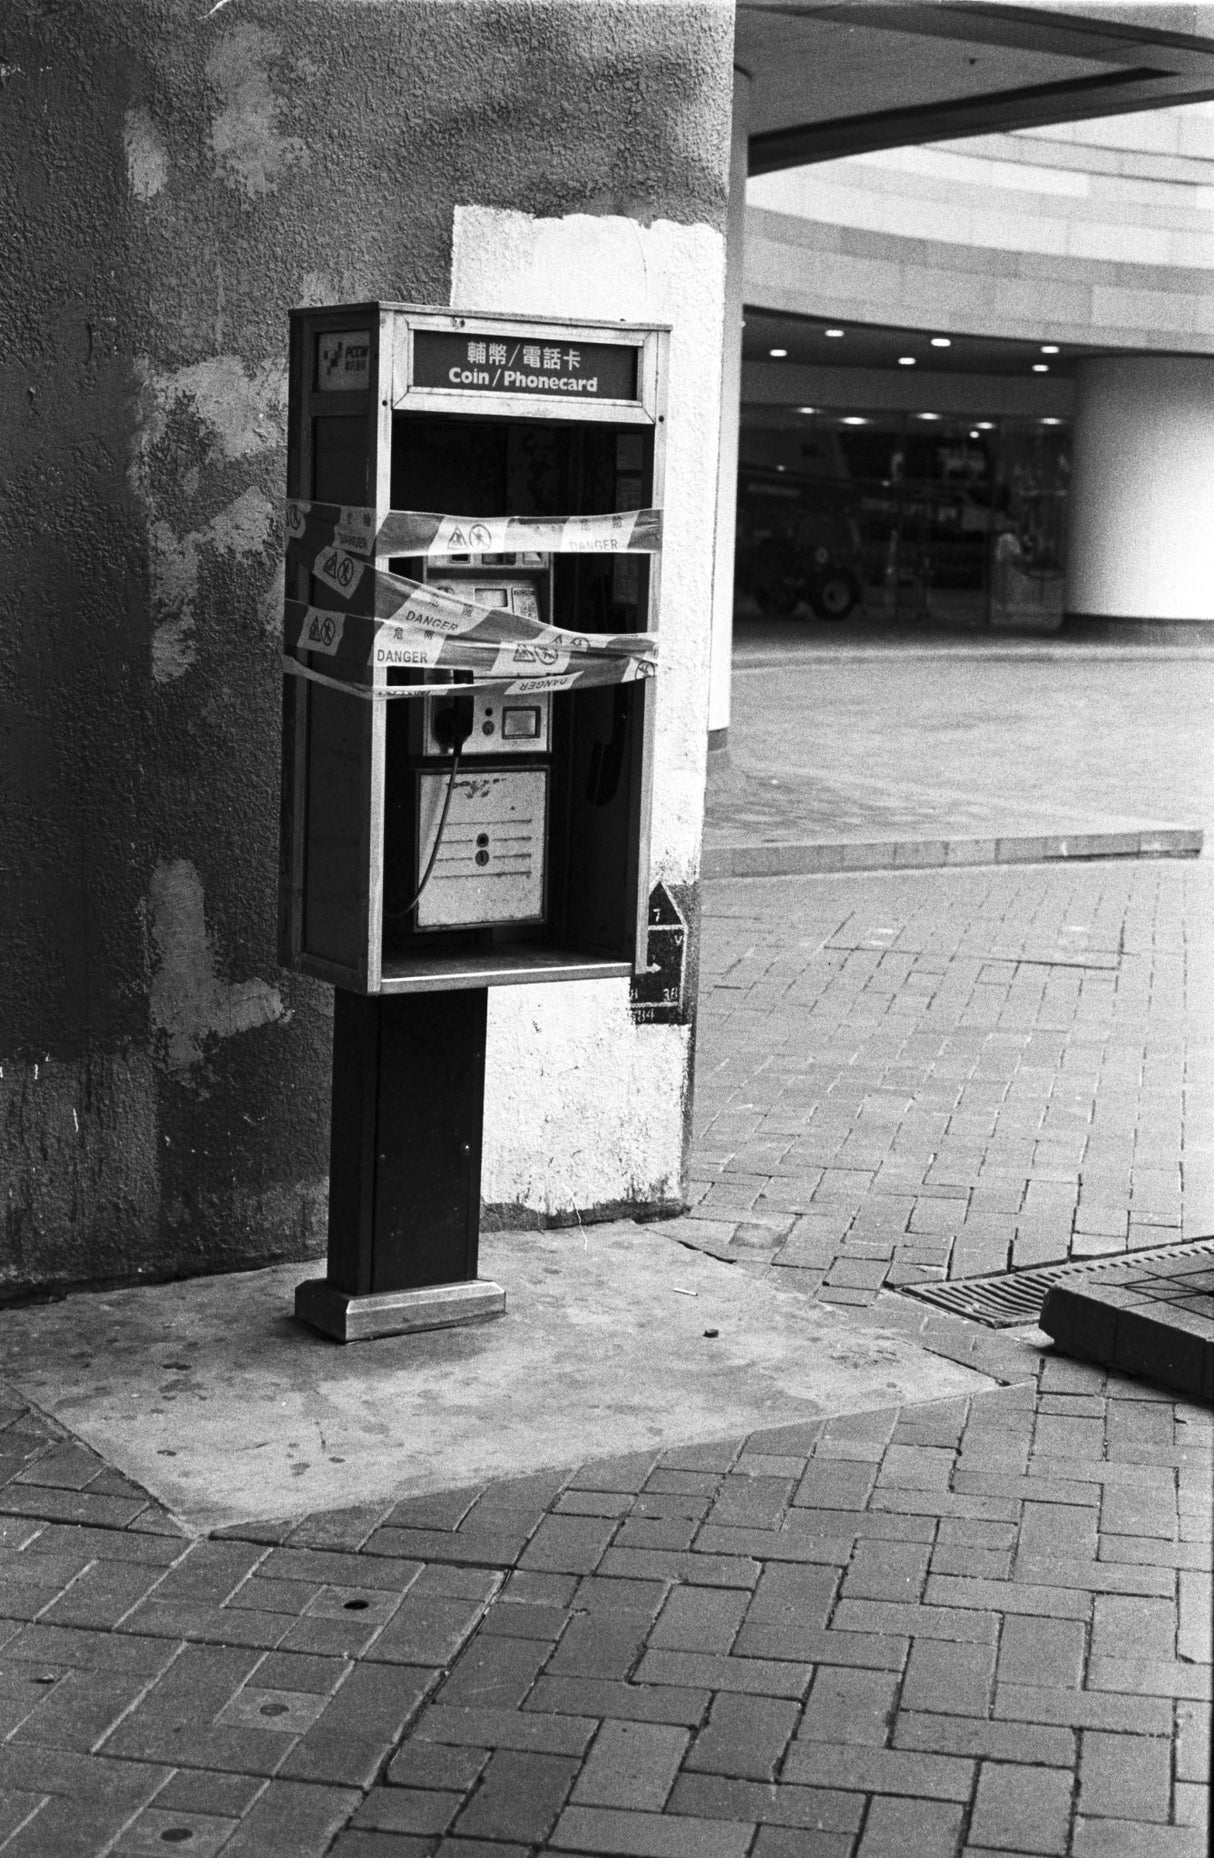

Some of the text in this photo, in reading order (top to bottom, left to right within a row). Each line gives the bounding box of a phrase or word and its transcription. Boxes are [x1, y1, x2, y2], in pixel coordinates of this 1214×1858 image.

[569, 539, 618, 551] DANGER
[405, 610, 459, 631] DANGER
[377, 649, 428, 663] DANGER
[519, 677, 568, 691] DANGER
